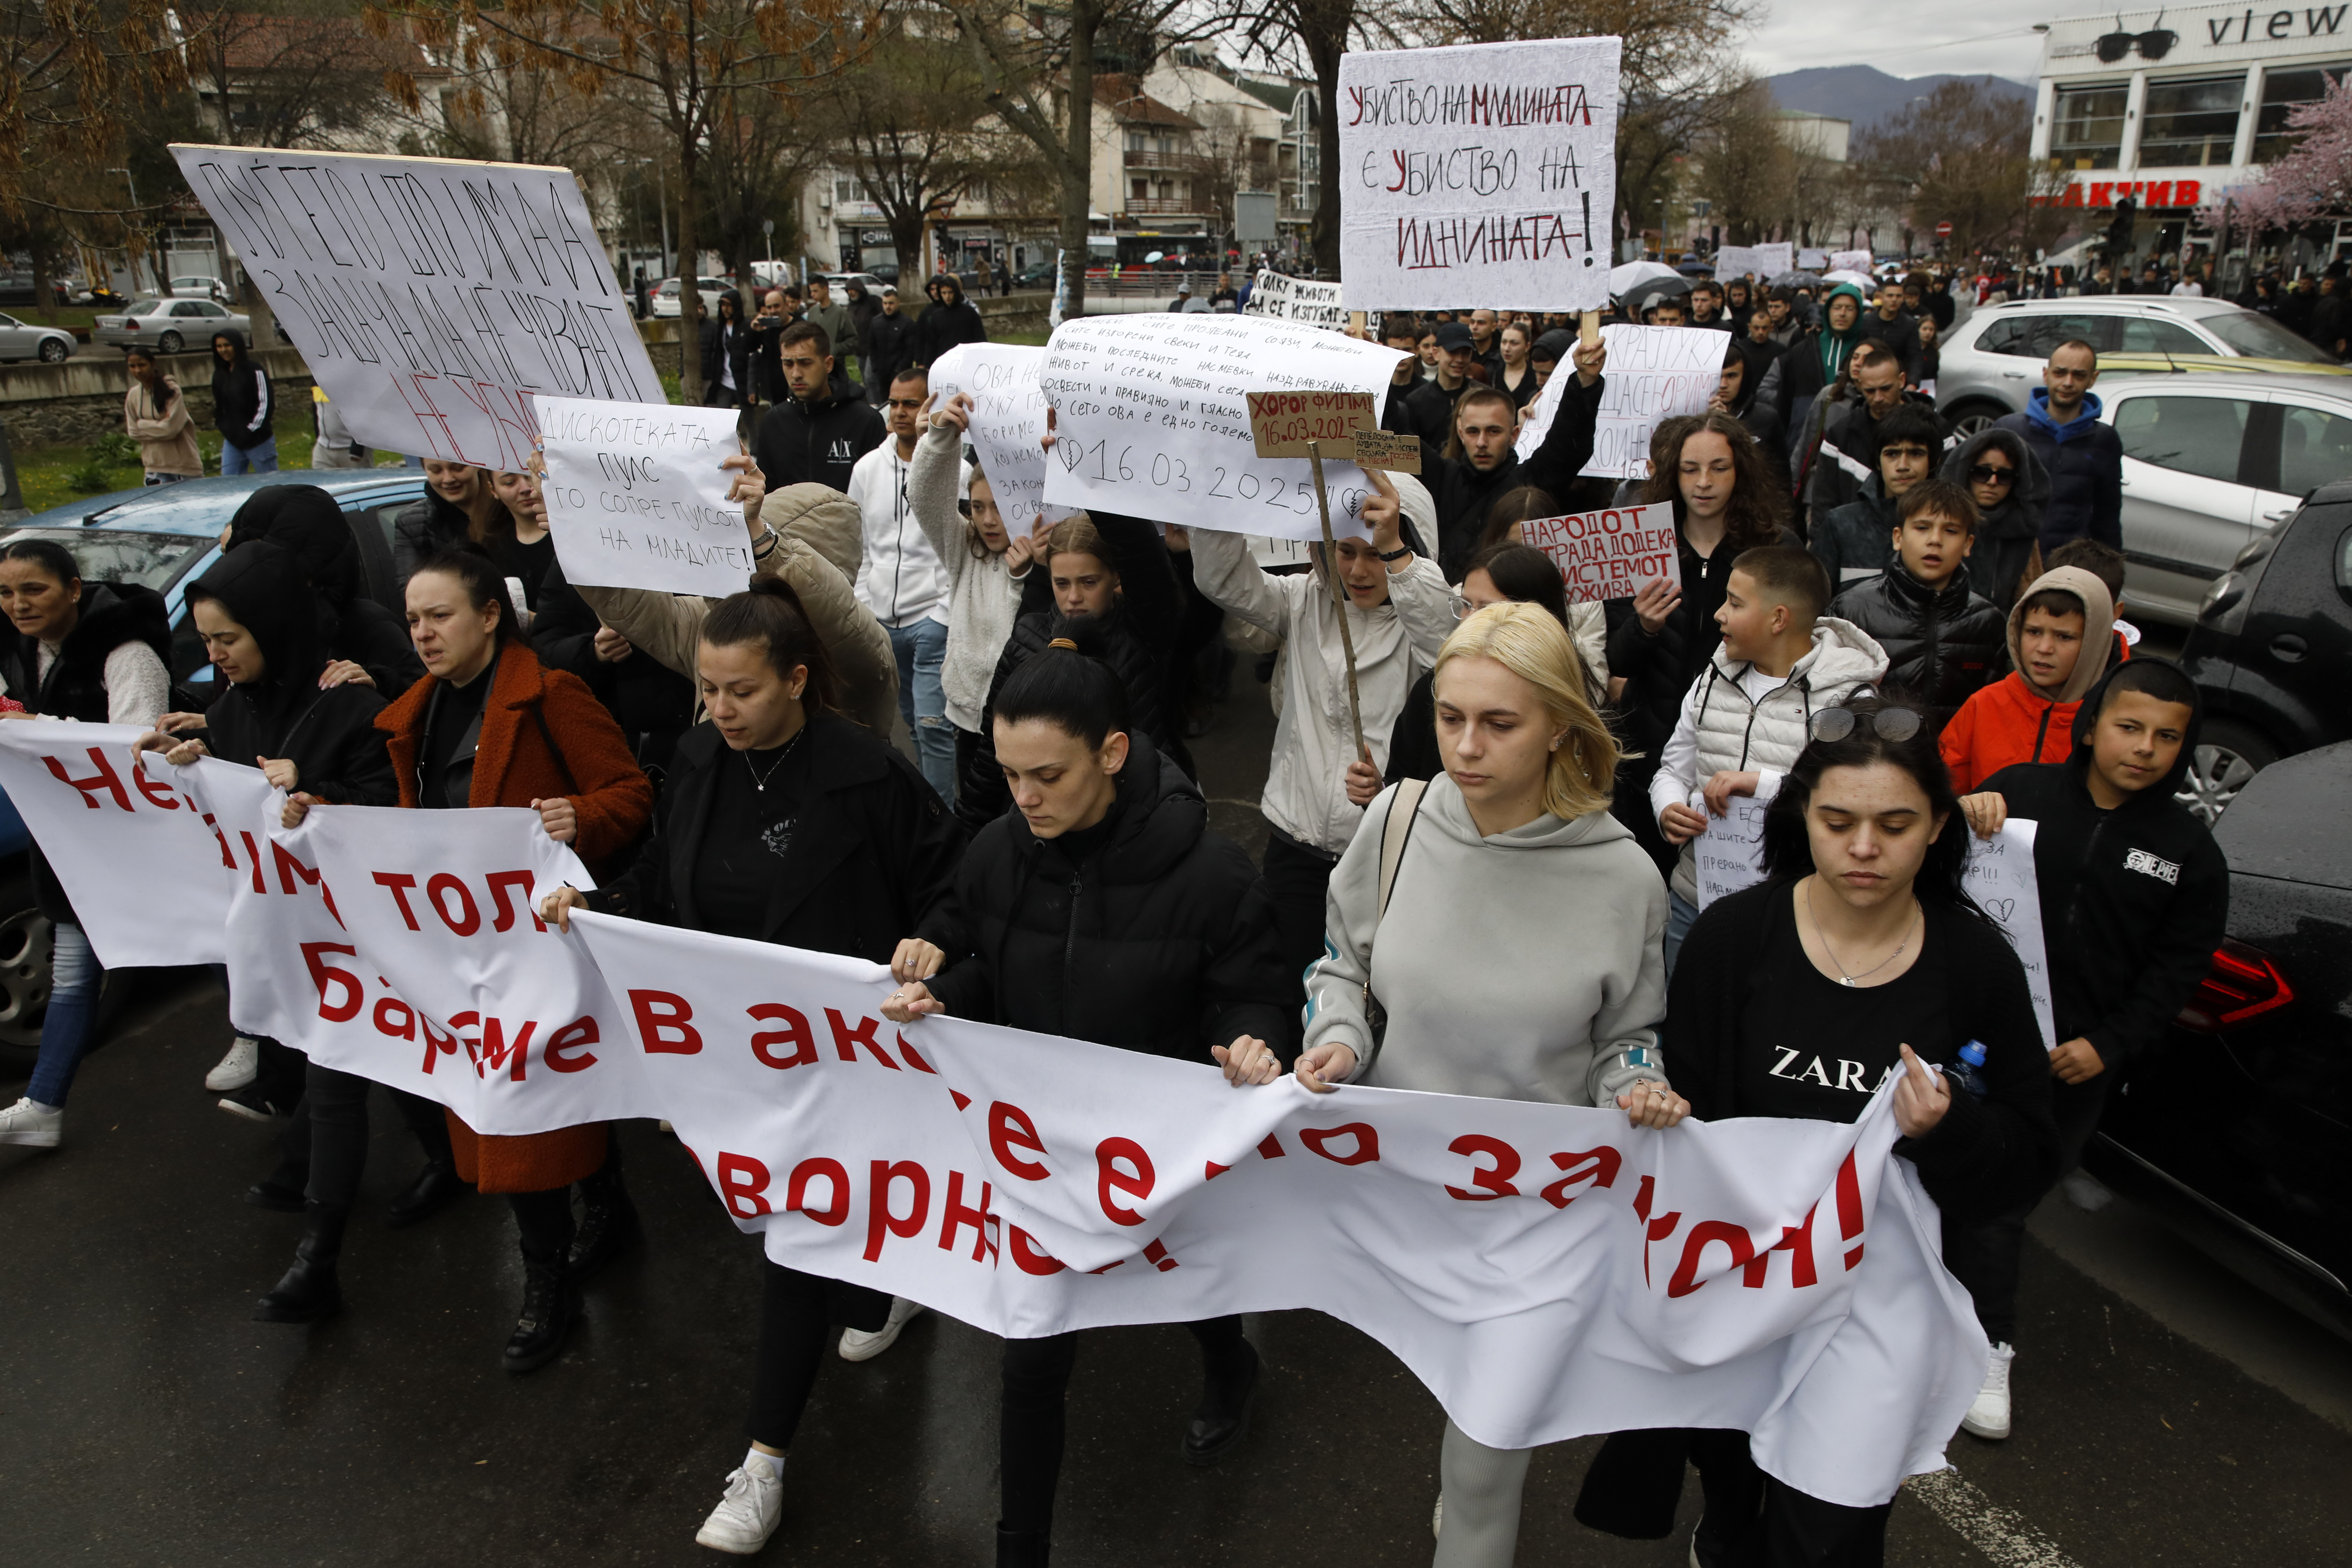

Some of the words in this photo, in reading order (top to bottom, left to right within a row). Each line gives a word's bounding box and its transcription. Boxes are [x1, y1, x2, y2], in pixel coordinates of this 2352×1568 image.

[2208, 4, 2349, 45] view
[1349, 79, 1438, 126] УБИСТВО
[1440, 83, 1469, 125] НА
[1386, 146, 1517, 196] УБИСТВО
[1538, 145, 1585, 192] НА
[2028, 180, 2201, 207] АКТИВ
[1398, 191, 1594, 269] ИДНИНАТА!
[1254, 273, 1290, 294] КОЛКУ
[1295, 284, 1336, 302] ЖИВОТИ
[1245, 294, 1264, 313] ДА
[1269, 299, 1286, 318] СЕ
[1291, 303, 1340, 323] ИЗГУБАТ
[1104, 362, 1114, 372] И
[1099, 385, 1107, 396] И
[1180, 398, 1189, 411] И
[1108, 405, 1134, 420] ОВА
[1248, 392, 1307, 419] ХОРОР
[541, 407, 710, 450] ДИСКОТЕКАТА
[1260, 416, 1360, 446] 16.03.2025
[598, 453, 660, 490] ПУЛС
[556, 487, 585, 509] ГО
[600, 491, 665, 519] СОПРЕ
[671, 501, 742, 531] ПУЛСОТ
[1521, 506, 1647, 545] НАРОДОТ
[599, 527, 632, 550] НА
[646, 534, 751, 571] МЛАДИТЕ!
[1538, 536, 1608, 566] ТРАДА
[1610, 528, 1677, 557] ДОДЕКА
[1561, 553, 1672, 585] ИСТЕМОТ
[40, 746, 182, 812] Не
[371, 869, 549, 938] тол
[1768, 1045, 1893, 1093] ZARA
